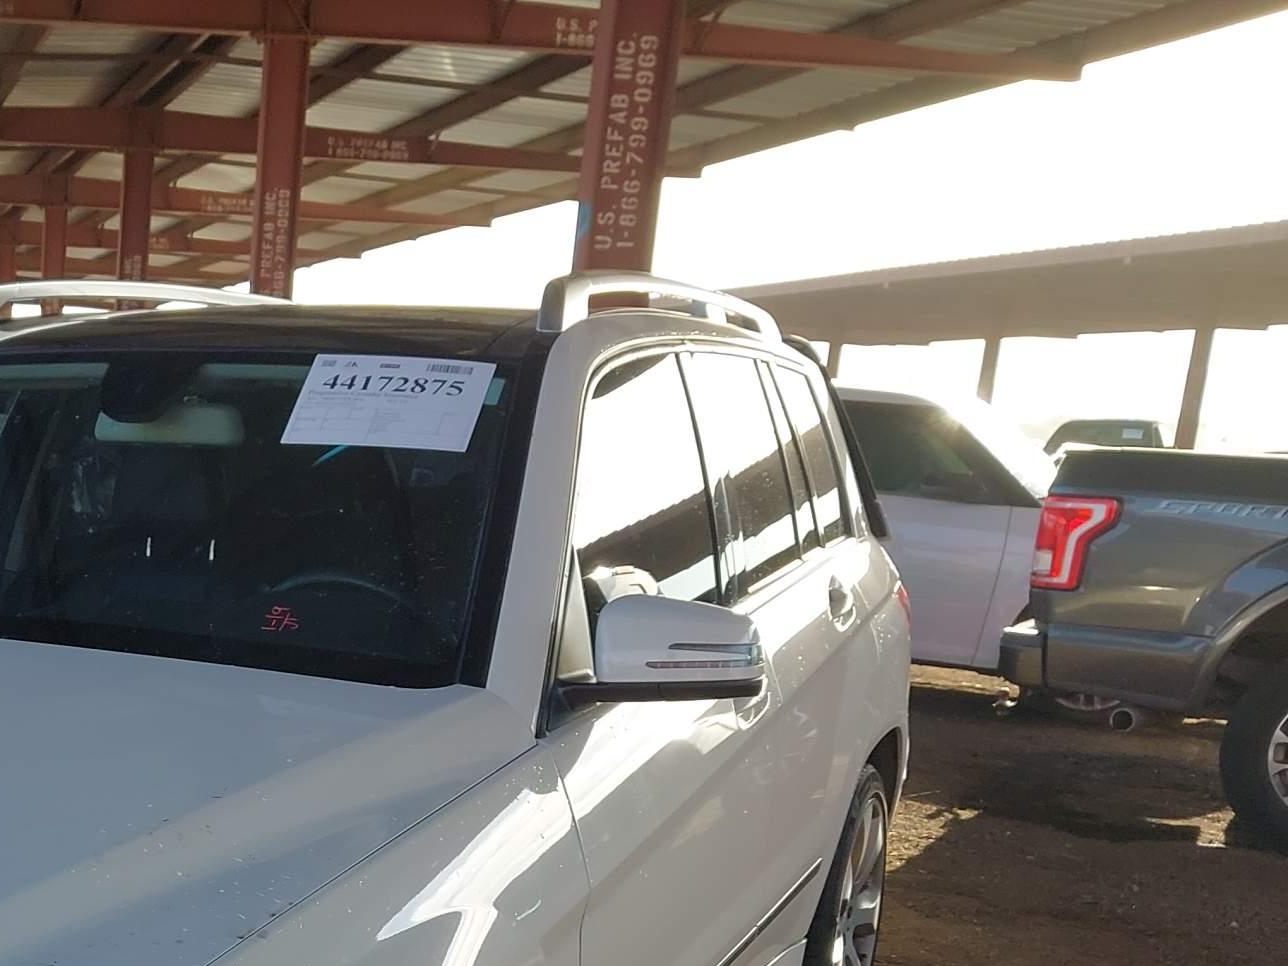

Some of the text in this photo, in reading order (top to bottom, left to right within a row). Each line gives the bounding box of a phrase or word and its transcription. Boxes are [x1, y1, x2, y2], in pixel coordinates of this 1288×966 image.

[594, 32, 637, 250] U.S. PREFAB INC.
[616, 34, 659, 248] 1-866-799-0969
[322, 374, 465, 396] 44172875
